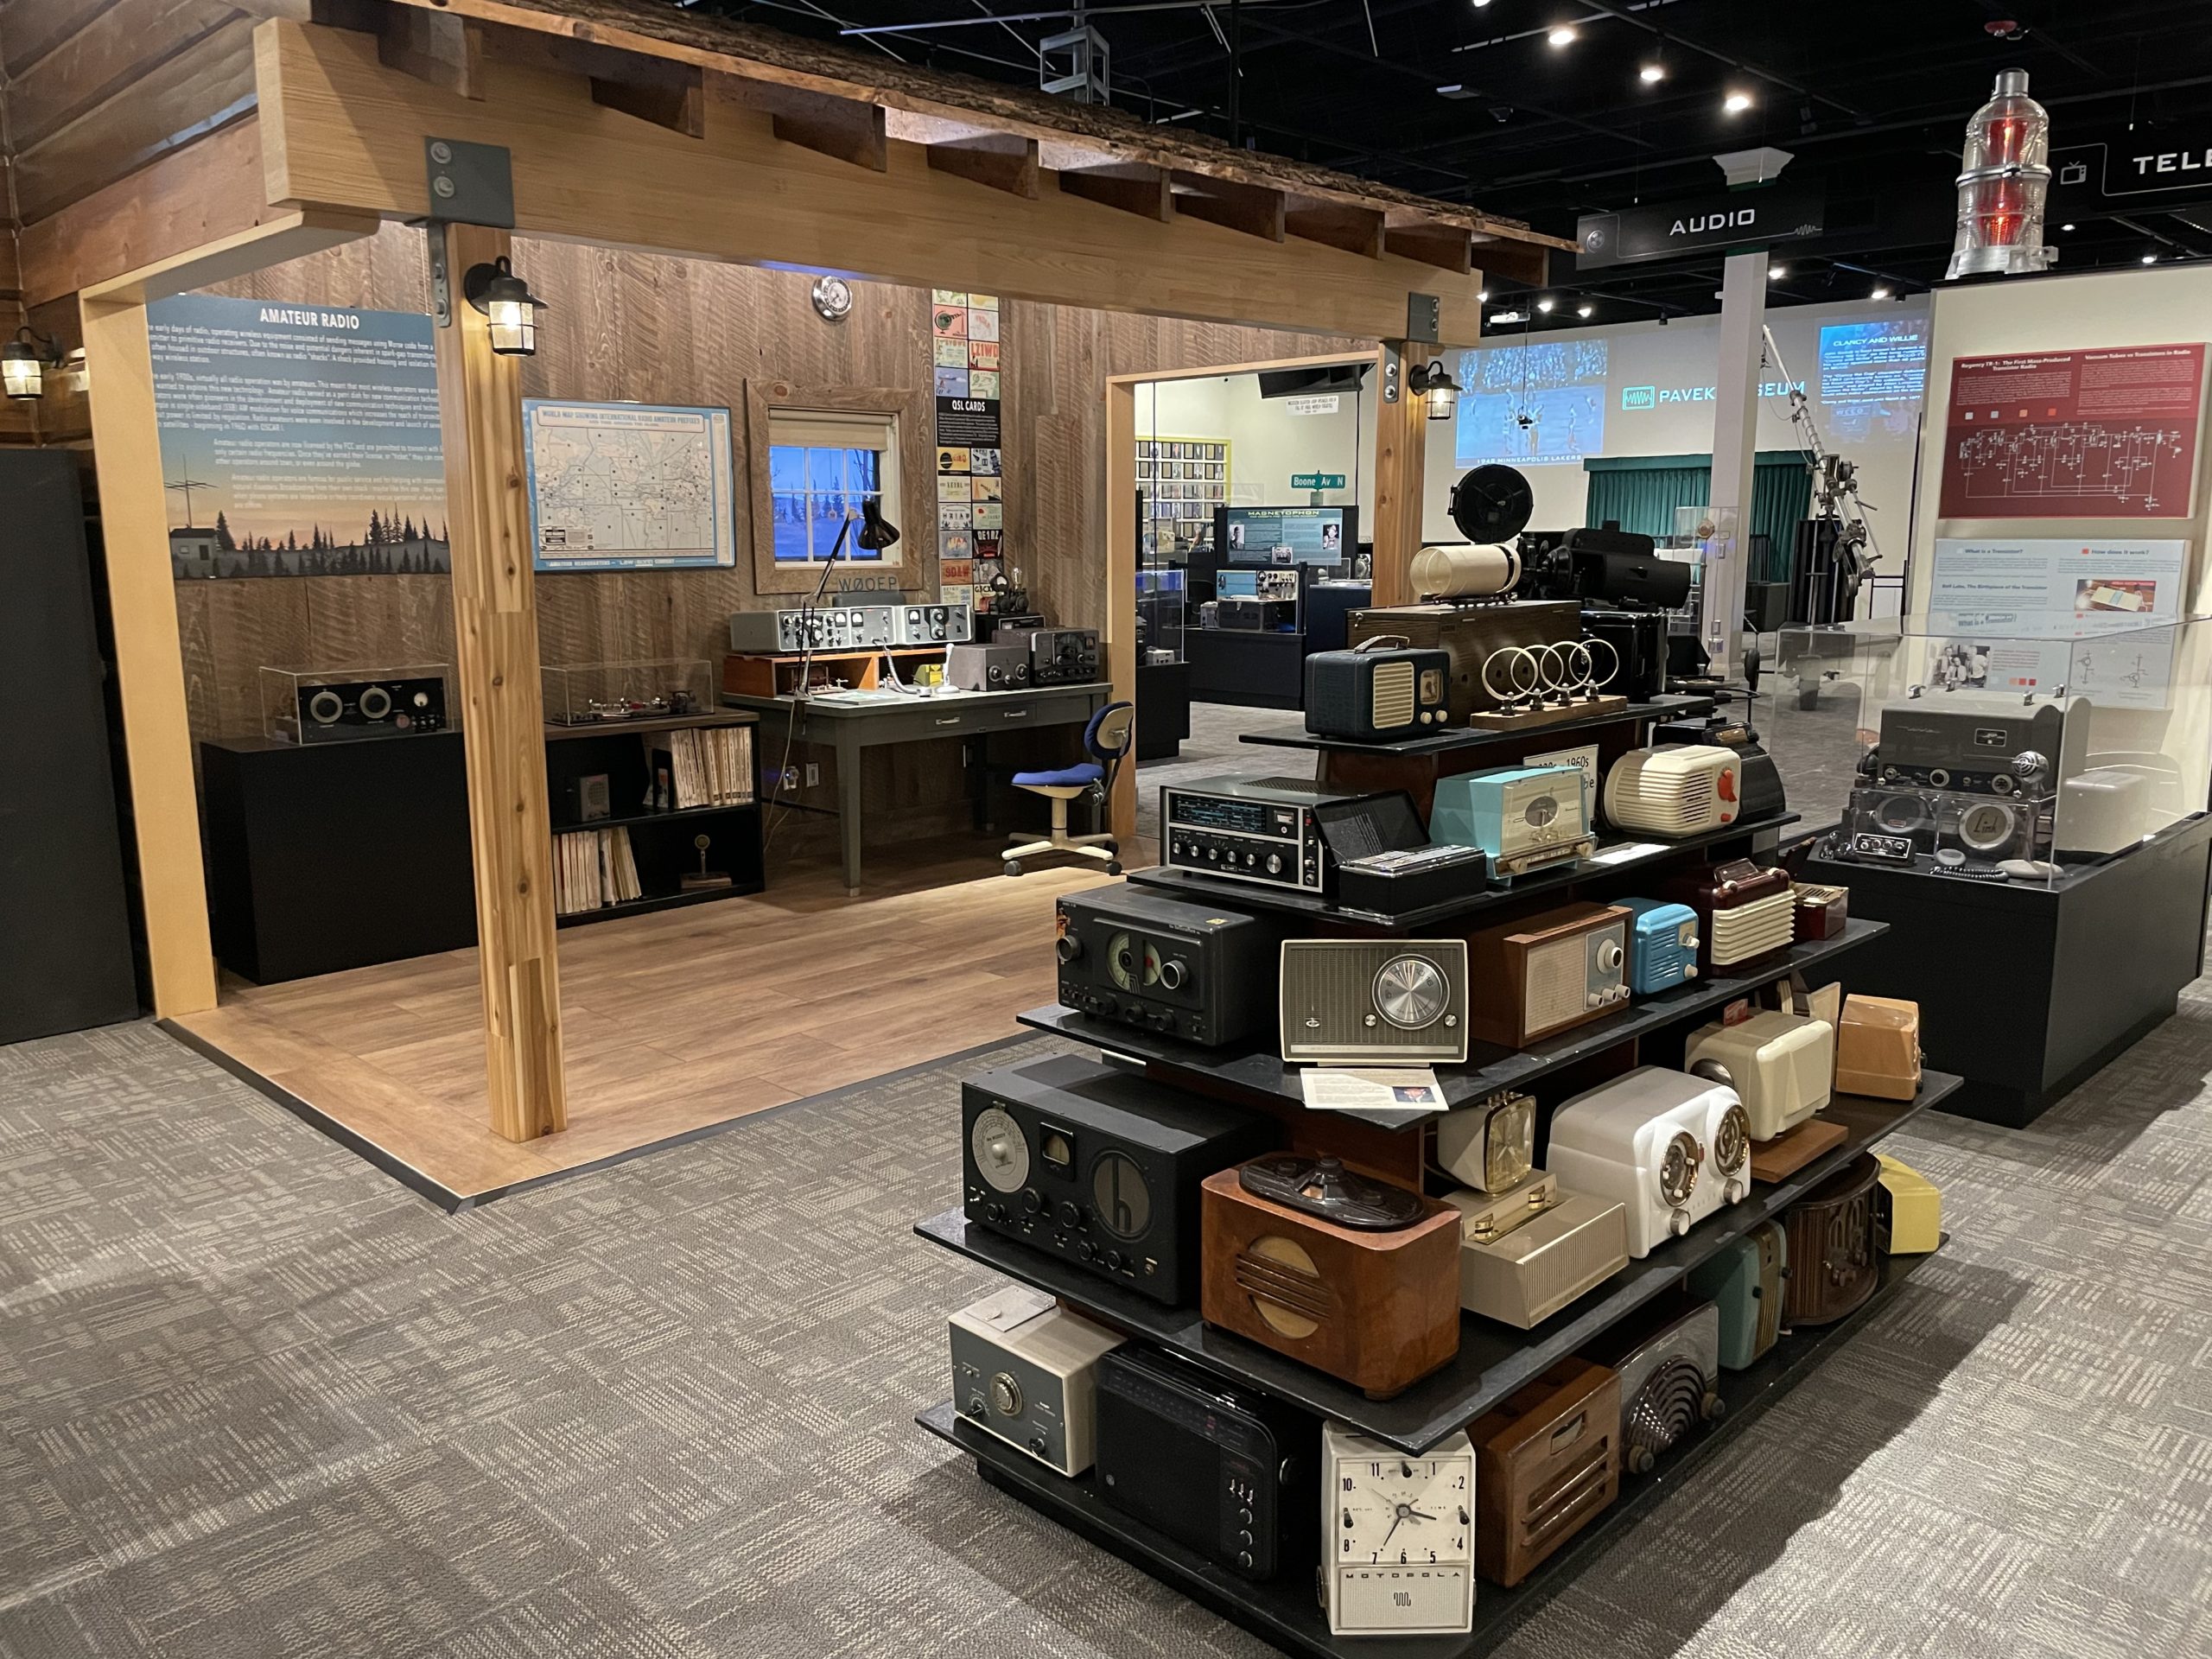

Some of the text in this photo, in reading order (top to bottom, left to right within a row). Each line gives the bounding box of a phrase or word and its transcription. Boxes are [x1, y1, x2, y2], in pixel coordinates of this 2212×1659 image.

[1669, 209, 1755, 236] AUDIO
[260, 308, 359, 329] AMATEUR RADIO
[1833, 338, 1867, 347] CLANCY
[1659, 386, 1716, 403] PAVEK
[952, 399, 985, 412] QSL CARDS
[1294, 477, 1343, 486] Boone Av N
[1567, 756, 1589, 767] 1960s
[1372, 1463, 1379, 1477] 11
[1432, 1462, 1436, 1475] 1
[1343, 1478, 1352, 1491] 10
[1459, 1476, 1464, 1489] 2
[1344, 1539, 1349, 1552] 8
[1457, 1537, 1463, 1550] 4
[1372, 1552, 1377, 1564] 7
[1401, 1552, 1407, 1564] 6
[1430, 1551, 1436, 1563] 5
